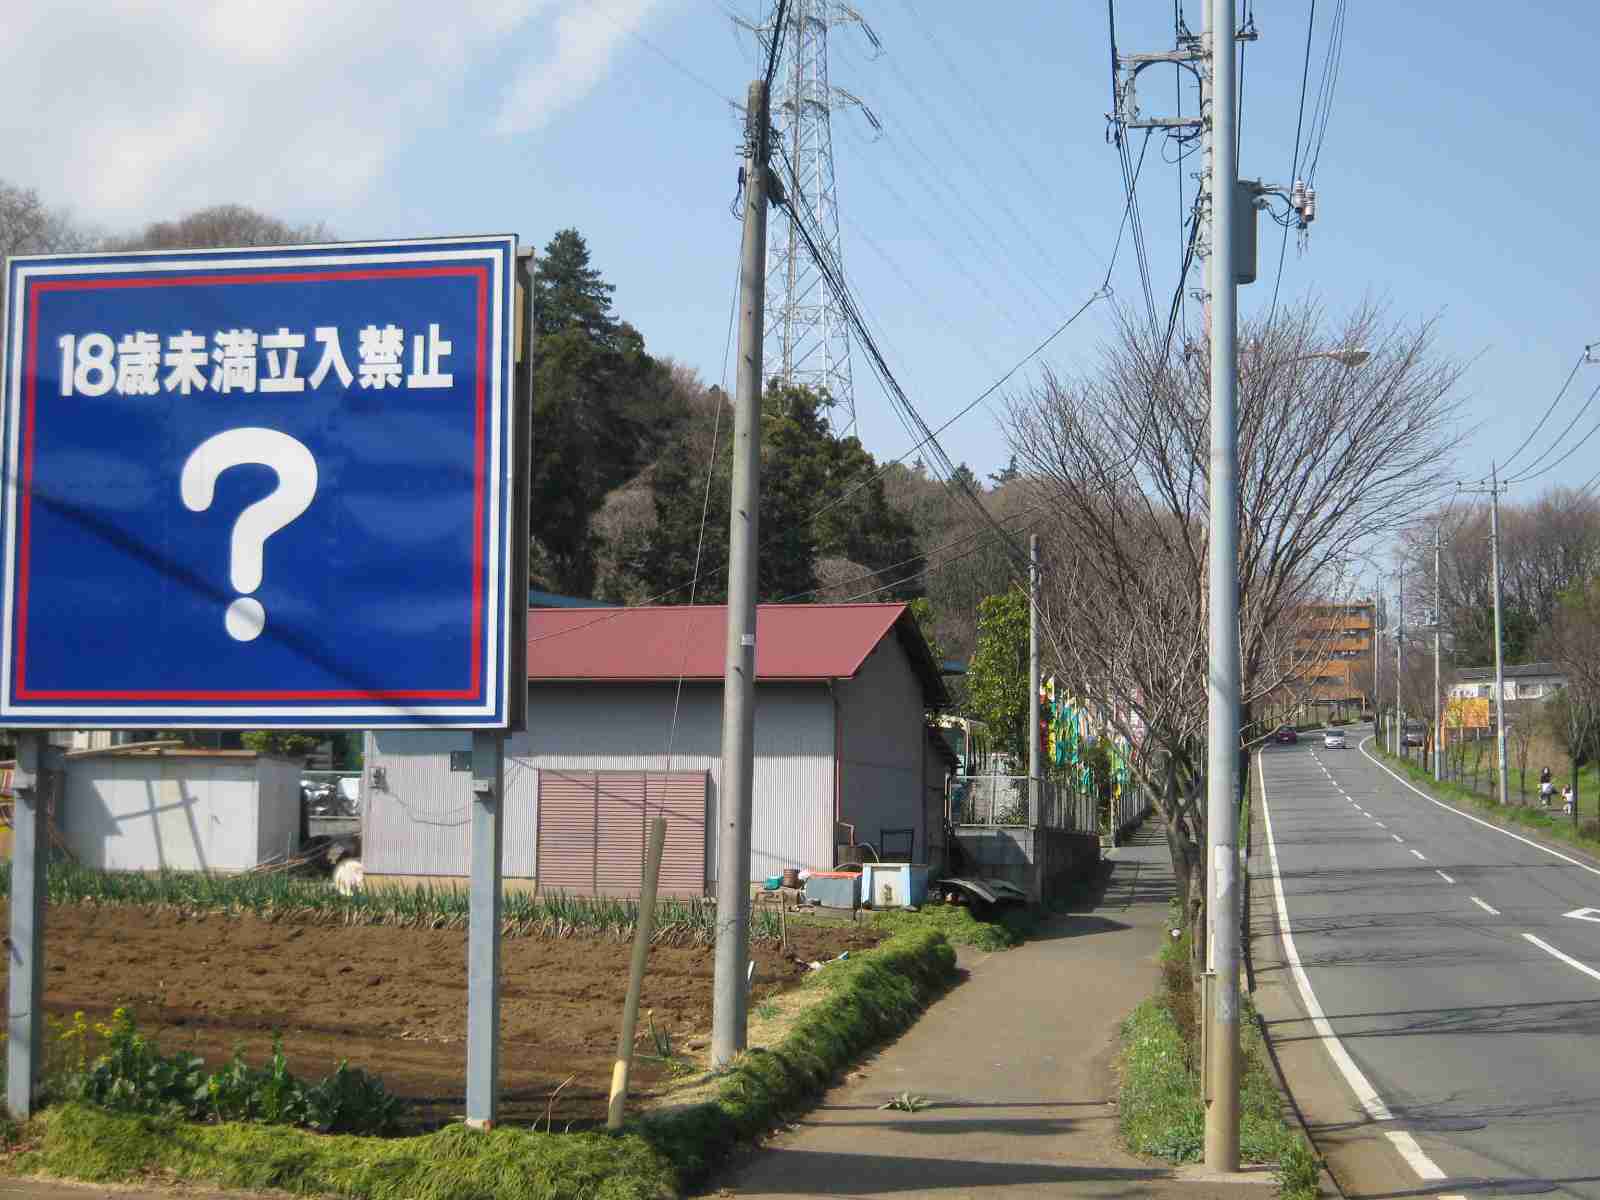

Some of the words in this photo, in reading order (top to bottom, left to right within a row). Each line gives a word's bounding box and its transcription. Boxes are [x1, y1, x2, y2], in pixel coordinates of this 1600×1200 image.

[58, 323, 454, 397] 18歳未満立入禁止
